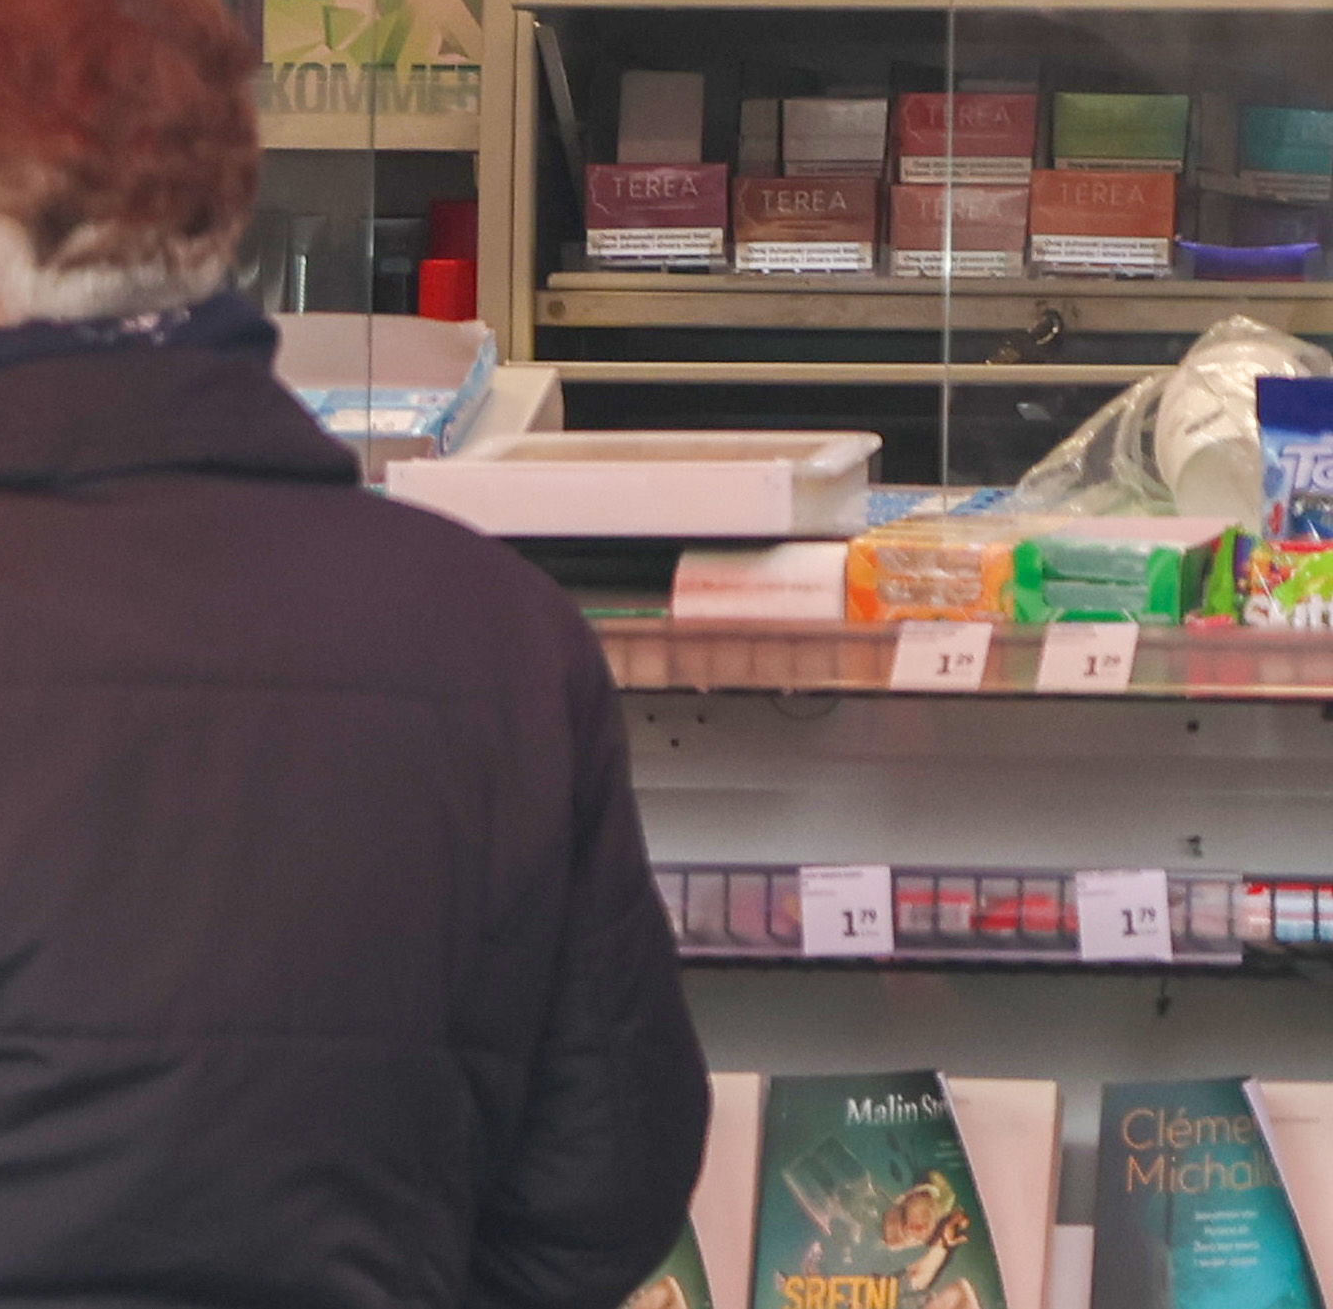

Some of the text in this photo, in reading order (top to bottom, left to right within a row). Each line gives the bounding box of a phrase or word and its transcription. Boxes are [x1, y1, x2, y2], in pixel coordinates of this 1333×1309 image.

[612, 176, 699, 199] TEREA
[1060, 182, 1146, 206] TEREA
[761, 190, 847, 213] TEREA
[845, 1096, 919, 1127] Malin
